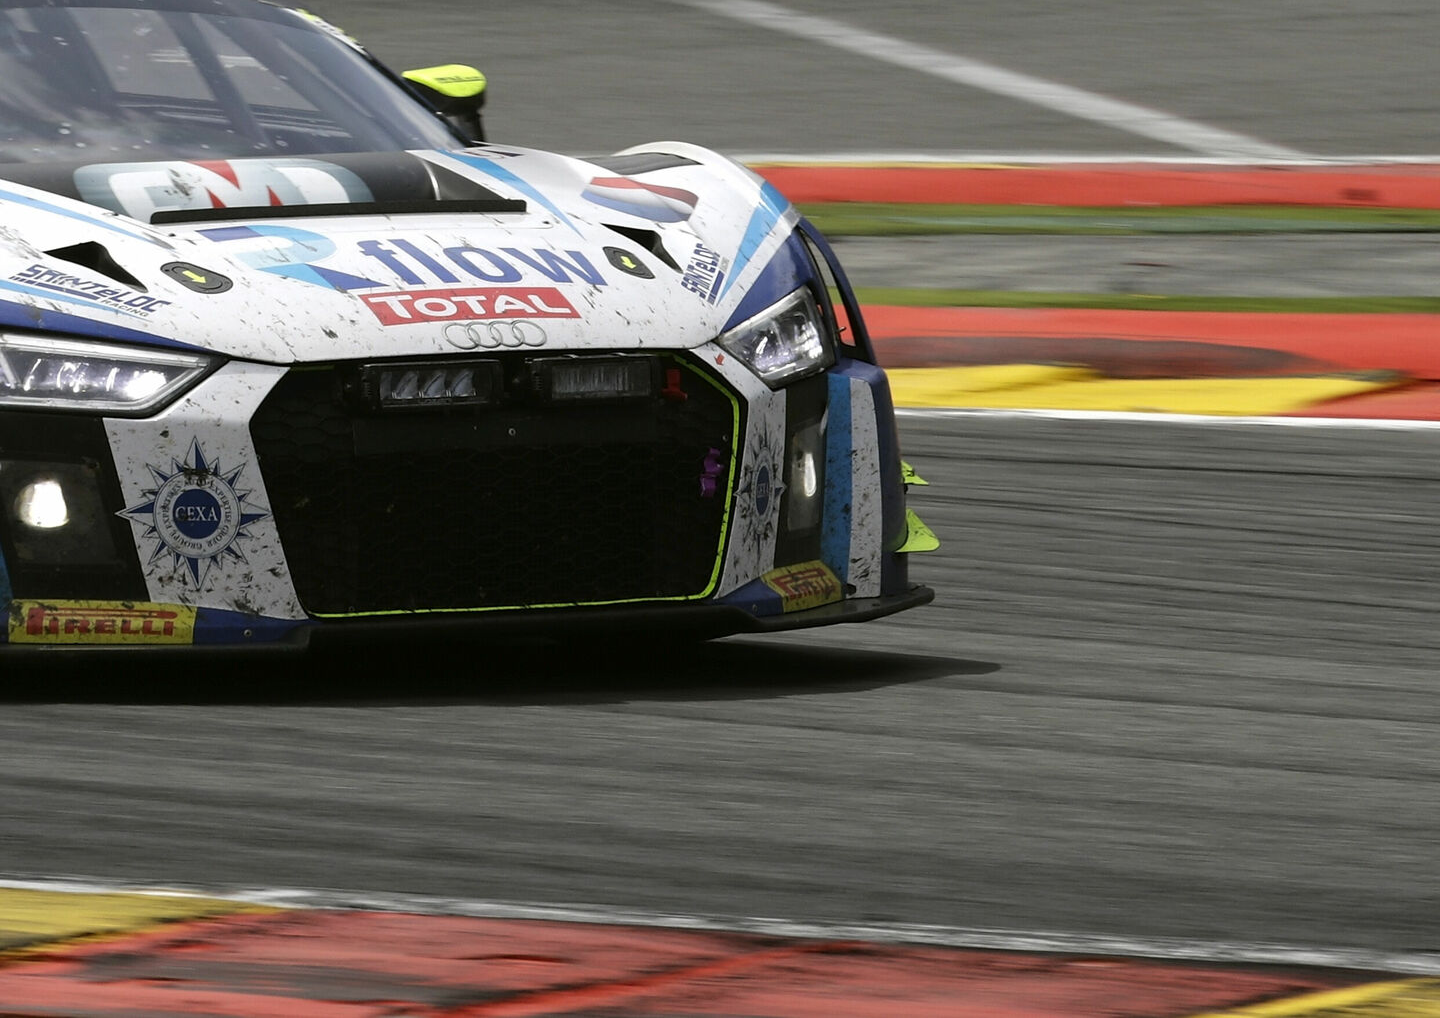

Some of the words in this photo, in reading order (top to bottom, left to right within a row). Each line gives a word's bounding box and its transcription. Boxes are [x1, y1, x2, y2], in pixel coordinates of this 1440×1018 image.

[101, 298, 150, 318] RACING
[367, 293, 573, 320] TOTAL
[26, 606, 178, 636] PIRELLI
